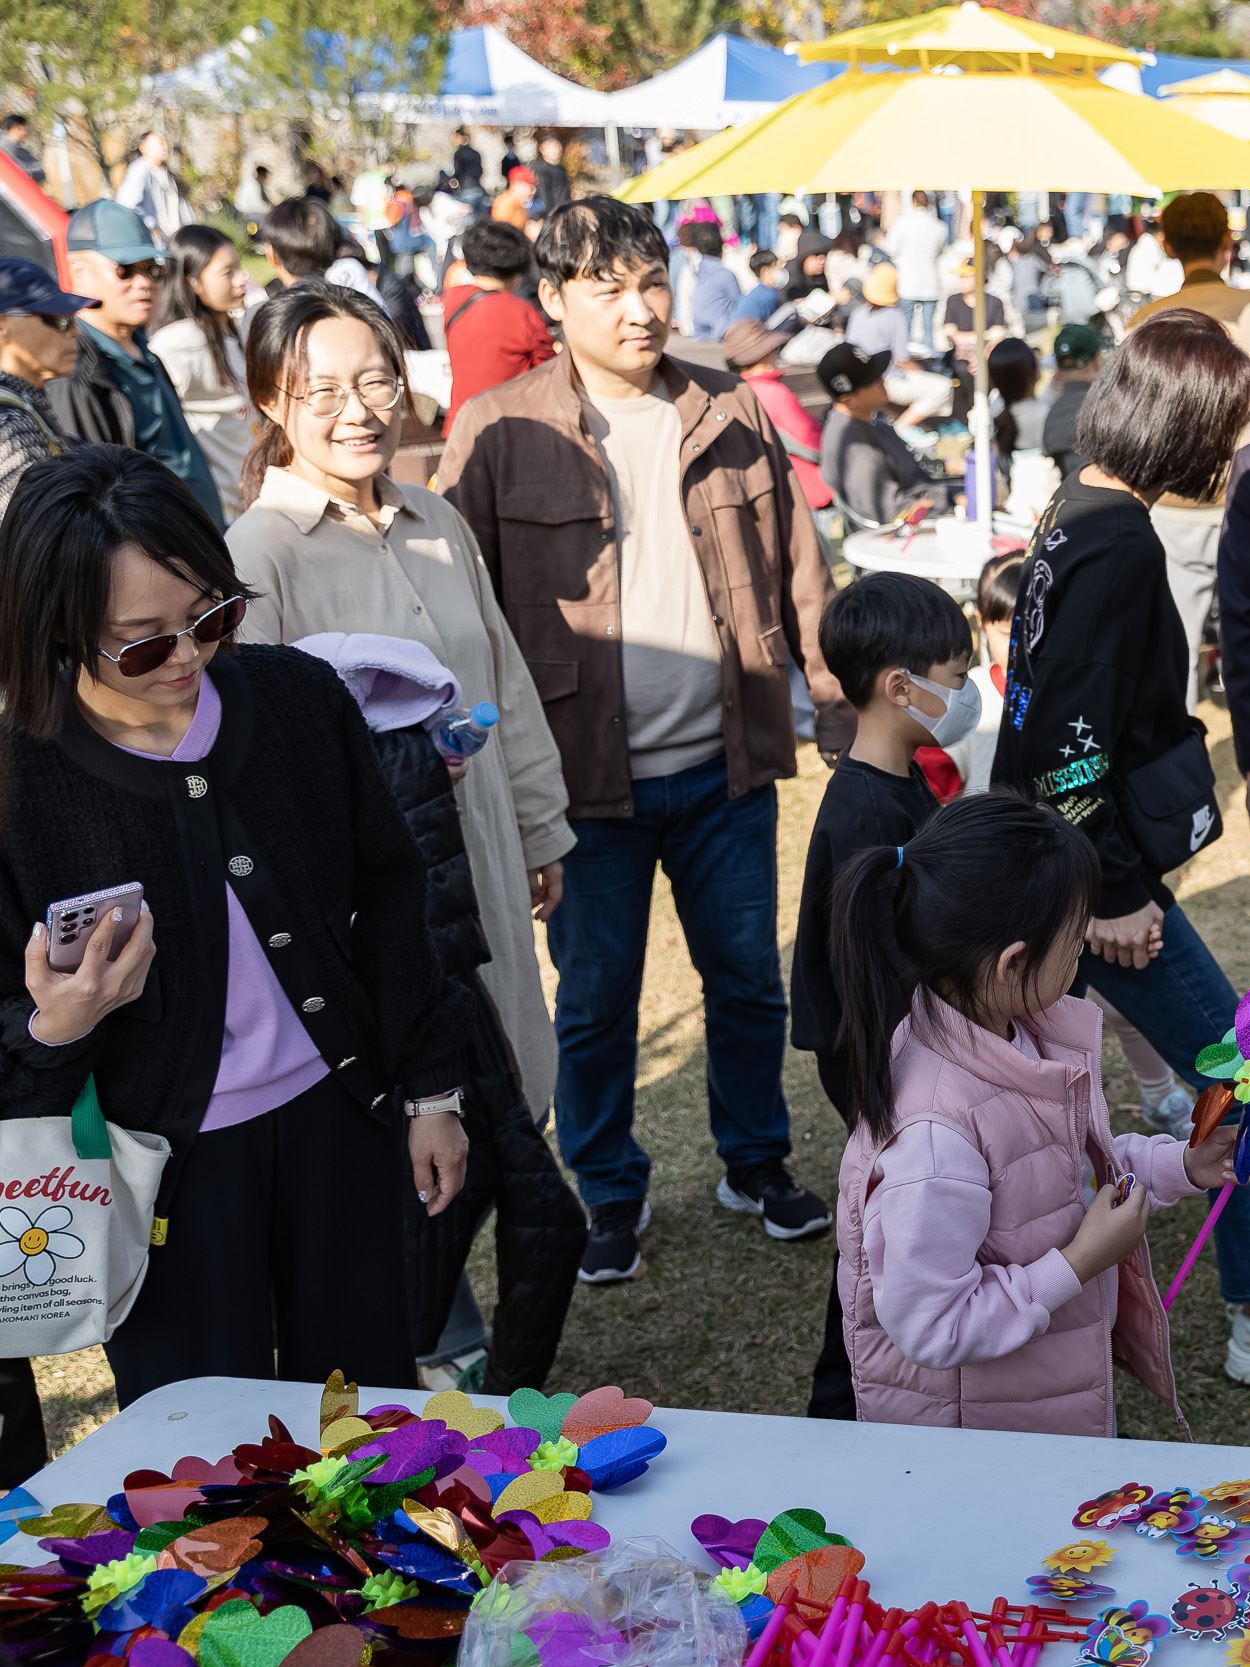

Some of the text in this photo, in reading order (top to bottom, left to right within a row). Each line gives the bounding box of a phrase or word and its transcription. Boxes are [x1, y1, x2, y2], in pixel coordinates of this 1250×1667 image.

[2, 1282, 31, 1291] brings
[48, 1275, 74, 1287] good
[74, 1274, 98, 1283] luck.
[17, 1290, 50, 1301] canvas
[50, 1288, 72, 1296] bag,
[20, 1303, 42, 1312] item
[43, 1299, 53, 1309] of
[53, 1298, 65, 1307] all
[65, 1298, 105, 1306] seasons.
[40, 1311, 71, 1320] KOREA
